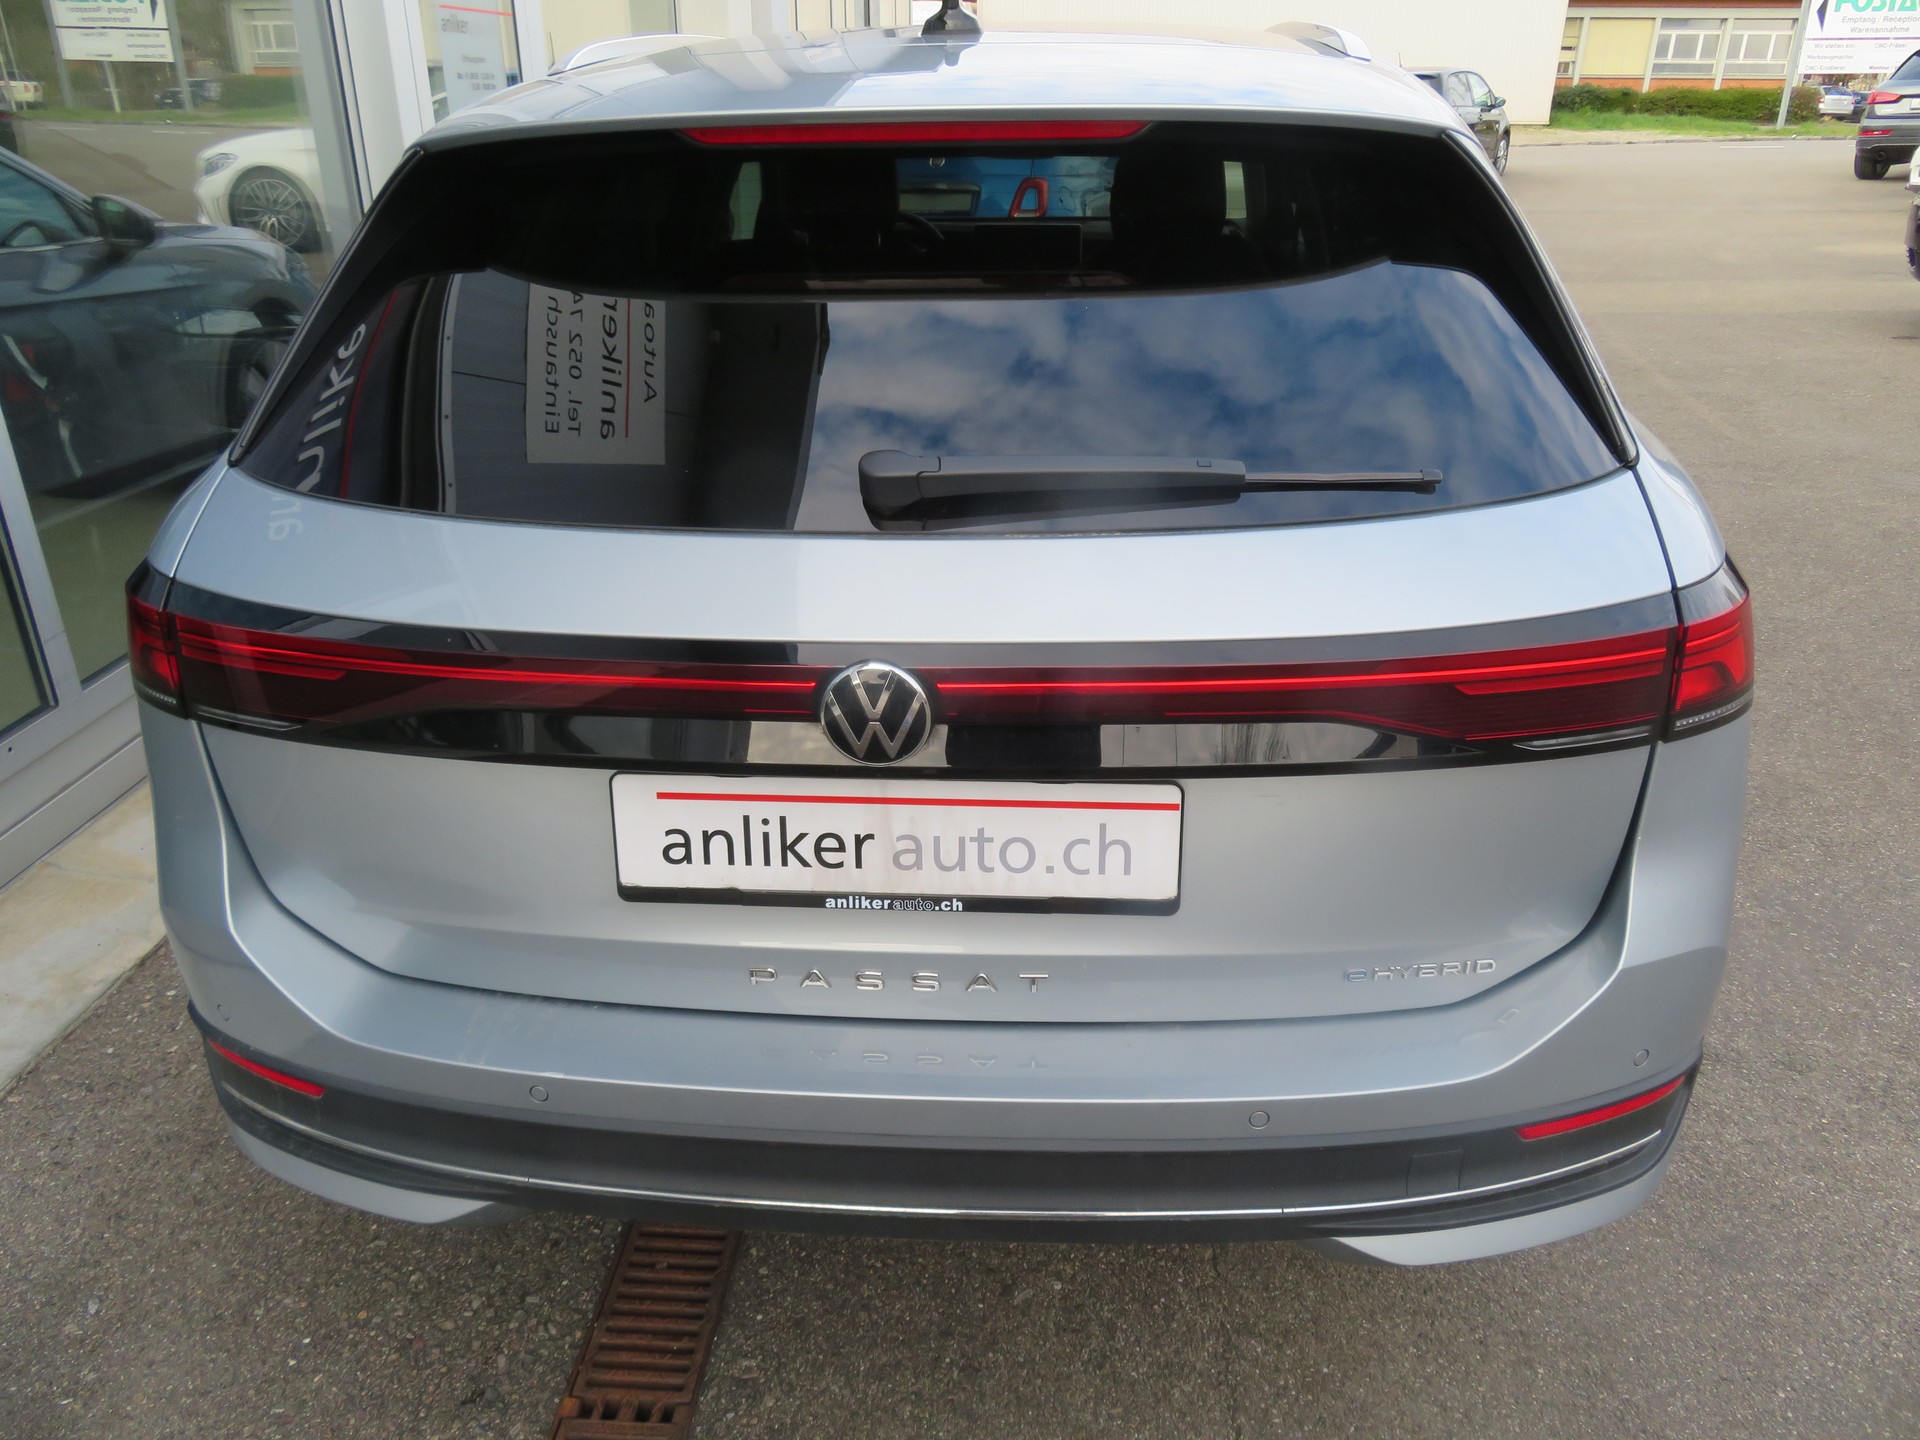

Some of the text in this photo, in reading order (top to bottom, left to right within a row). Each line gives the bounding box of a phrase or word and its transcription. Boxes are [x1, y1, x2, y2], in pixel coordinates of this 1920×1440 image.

[1841, 16, 1876, 25] Empfang
[1850, 26, 1910, 34] Warenannahme
[661, 814, 1134, 877] anliker auto.ch
[749, 966, 1050, 994] PASSAT
